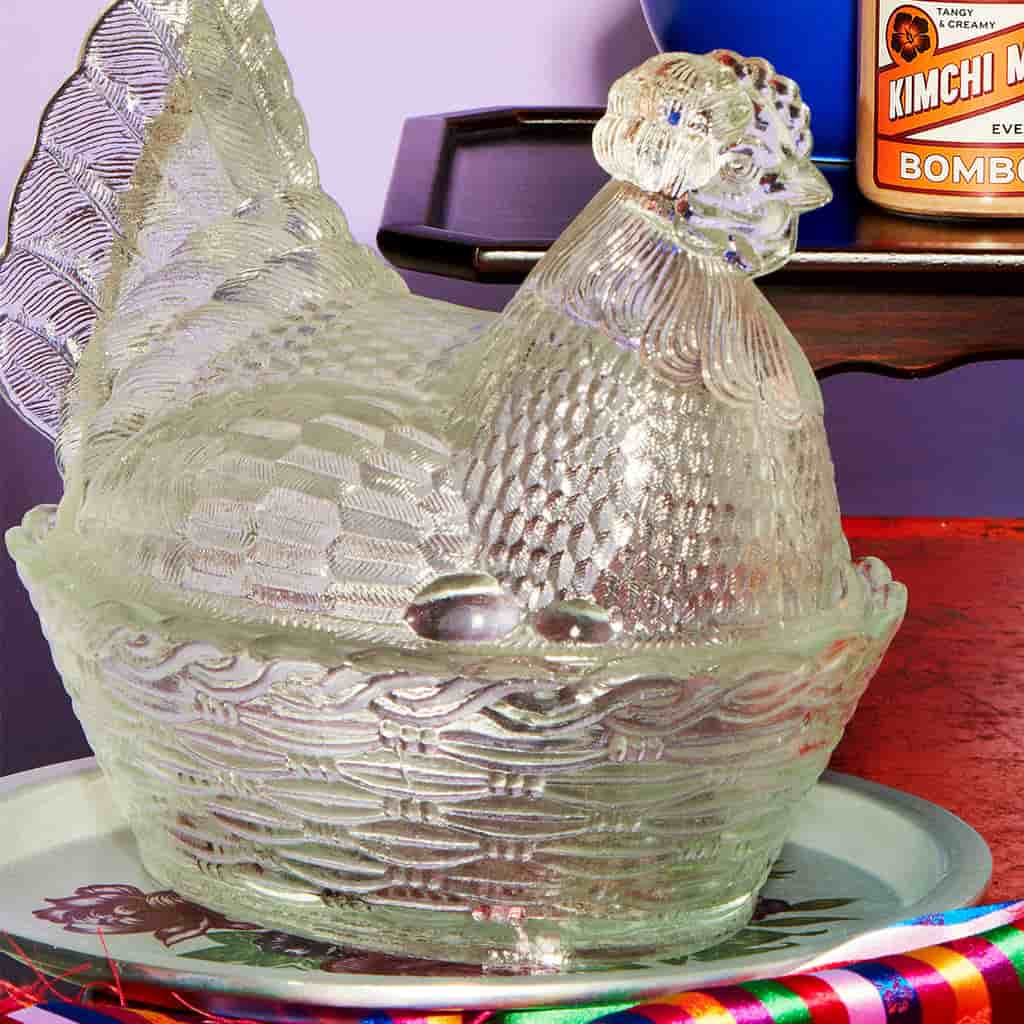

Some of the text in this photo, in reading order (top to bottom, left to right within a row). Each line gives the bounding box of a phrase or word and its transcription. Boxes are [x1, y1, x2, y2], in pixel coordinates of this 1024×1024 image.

[936, 7, 974, 17] TANGY
[947, 20, 996, 30] CREAMY
[889, 52, 995, 121] KIMCHI
